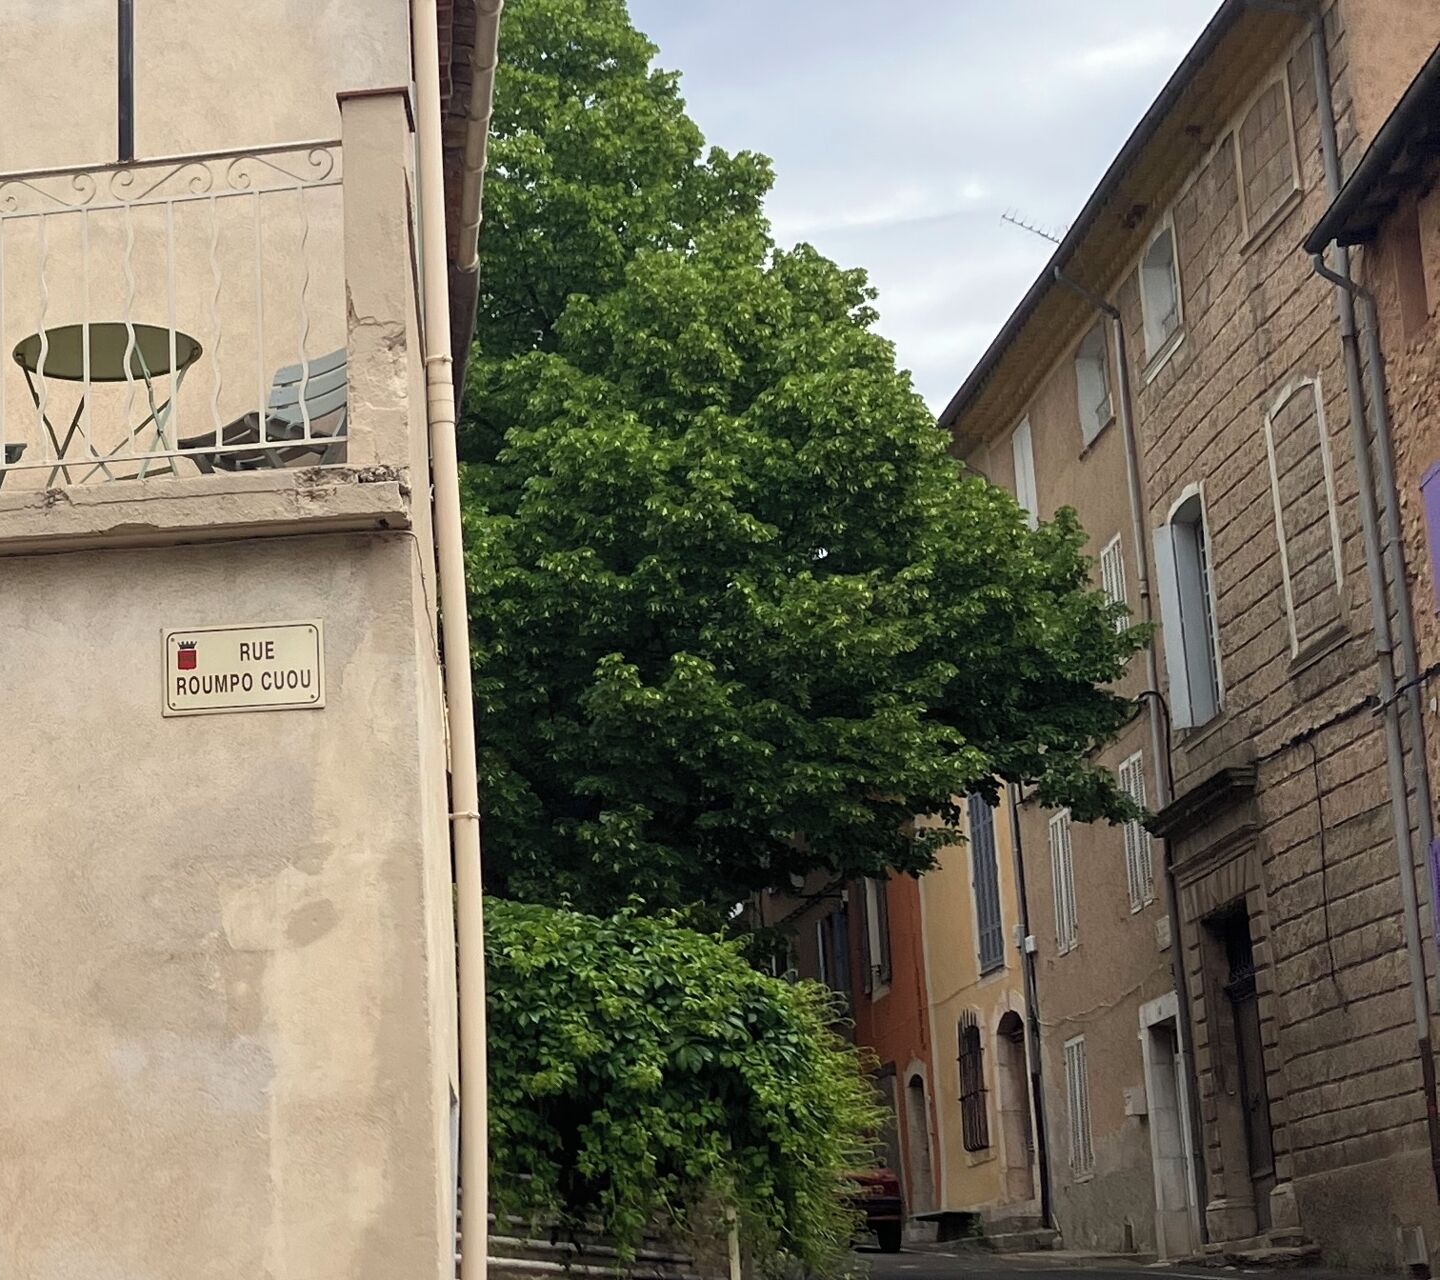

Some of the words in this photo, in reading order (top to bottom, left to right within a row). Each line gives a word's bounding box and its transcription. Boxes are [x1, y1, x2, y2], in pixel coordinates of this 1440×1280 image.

[239, 641, 275, 661] RUE
[176, 672, 253, 695] ROUMPO
[261, 669, 311, 691] CUOU
